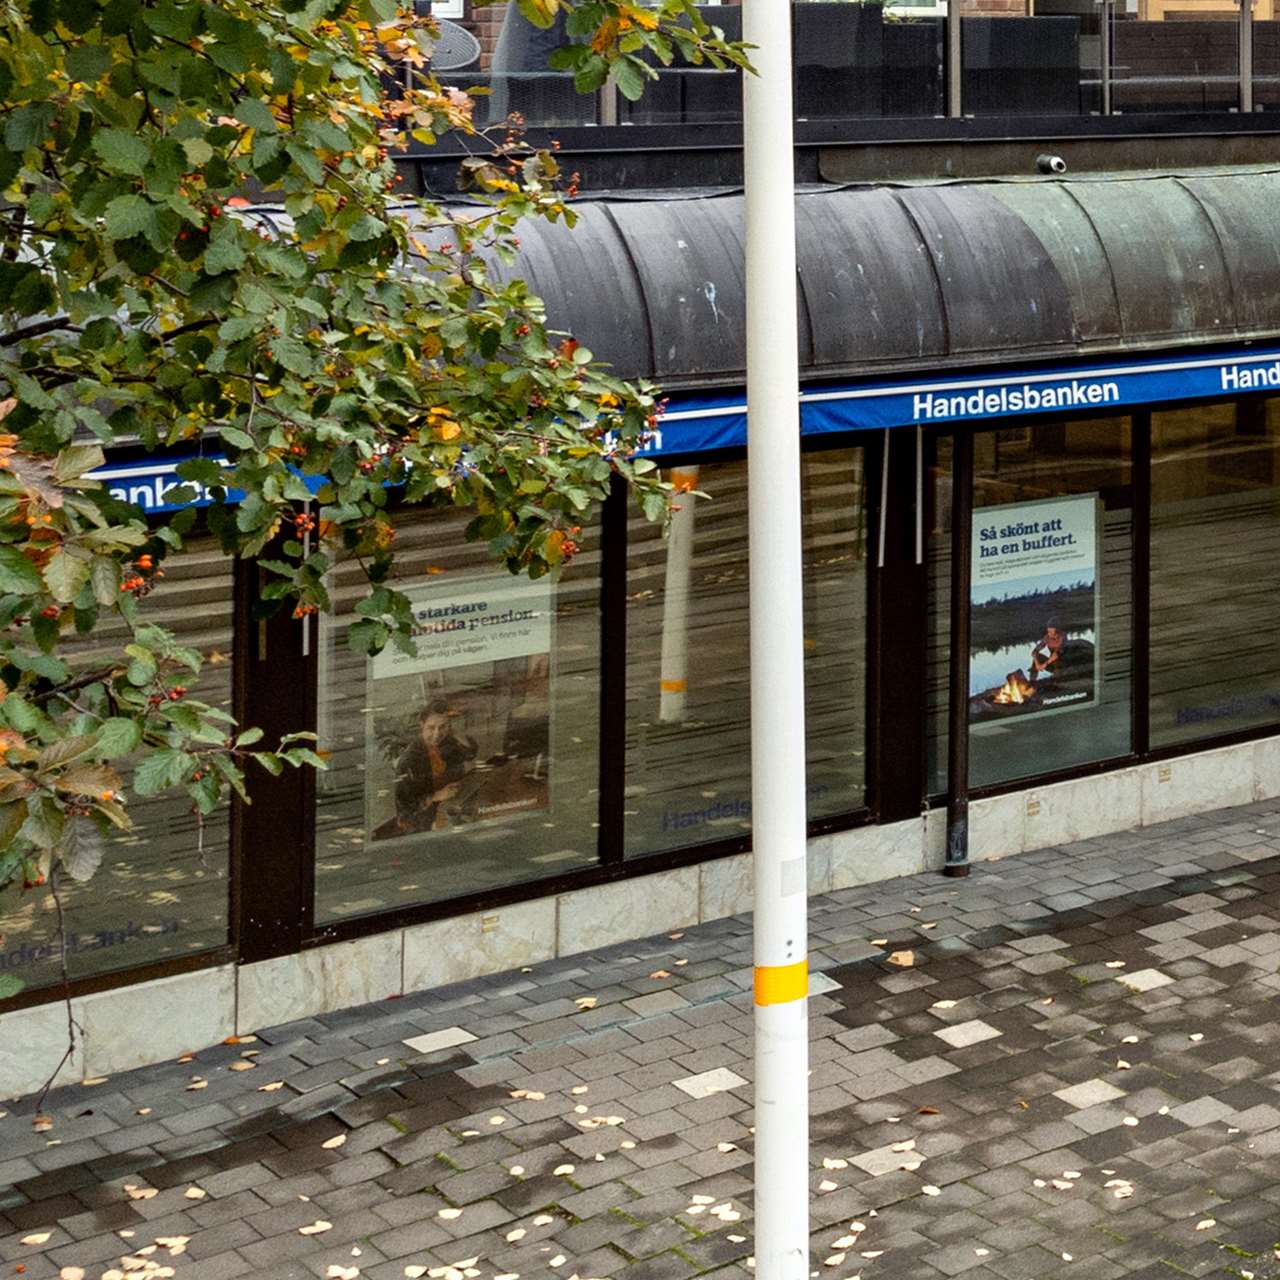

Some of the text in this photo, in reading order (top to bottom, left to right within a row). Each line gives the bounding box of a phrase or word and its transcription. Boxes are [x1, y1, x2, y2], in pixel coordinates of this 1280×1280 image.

[912, 379, 1120, 420] Handelsbanken
[980, 518, 1063, 542] Så skönt att
[980, 533, 1077, 558] ha en buffert.
[418, 600, 489, 621] starkare
